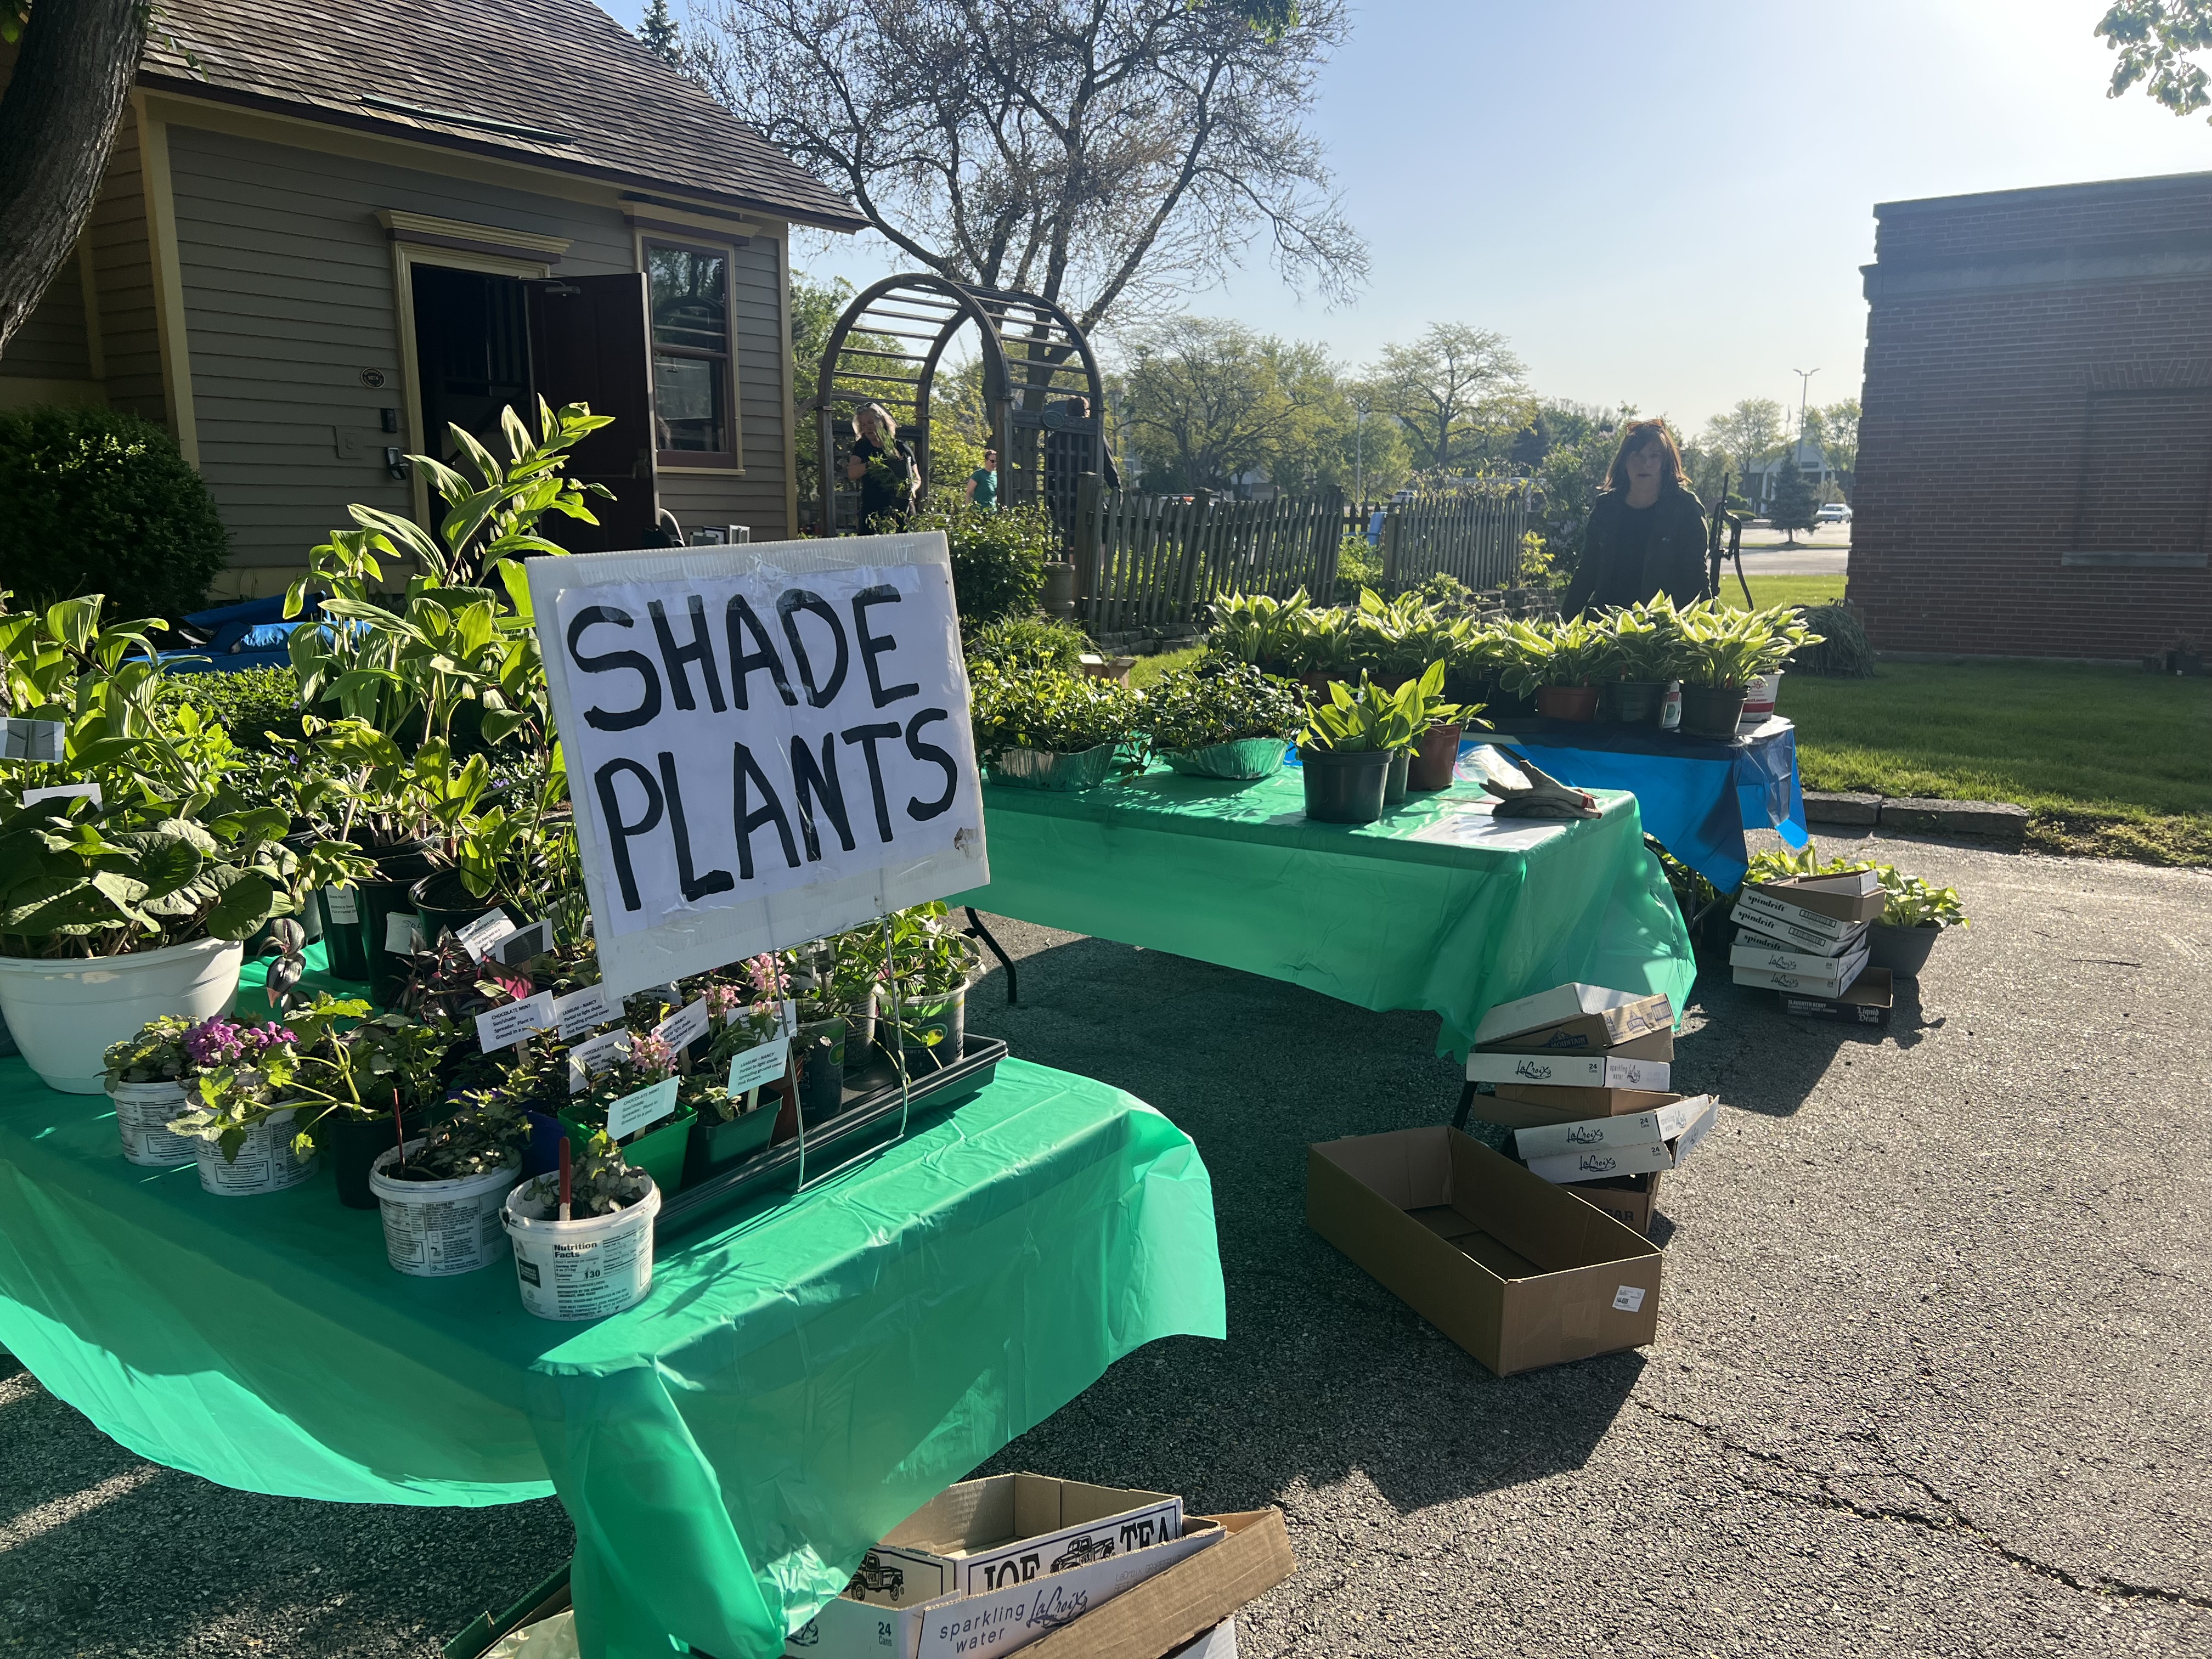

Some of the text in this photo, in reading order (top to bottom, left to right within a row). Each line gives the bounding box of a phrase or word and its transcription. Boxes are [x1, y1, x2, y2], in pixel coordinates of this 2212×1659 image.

[567, 584, 919, 731] SHADE
[594, 708, 958, 911] PLANTS
[1748, 894, 1785, 912] spindrift
[1737, 910, 1775, 929] spindrift
[1744, 933, 1781, 951] spindrift
[492, 1003, 531, 1020] CHOCOLATE MINT
[562, 999, 597, 1015] LAMIUM NANCY
[564, 1013, 577, 1022] Partial
[582, 1009, 591, 1017] light
[591, 1004, 602, 1012] shade
[1857, 1006, 1879, 1015] Liquid
[493, 1015, 517, 1027] Sun/shade
[565, 1019, 584, 1029] Spreading
[584, 1013, 599, 1022] ground
[675, 1016, 686, 1025] NANCY
[1858, 1014, 1878, 1023] Death
[494, 1024, 516, 1034] Spreader.
[495, 1031, 512, 1040] Ground
[1551, 1037, 1586, 1048] MOUNTAIN
[582, 1046, 604, 1057] CHOCOLATE
[741, 1058, 757, 1068] LAMIUM
[1515, 1060, 1551, 1079] LaCroix
[1610, 1064, 1628, 1074] sparkling
[738, 1071, 757, 1080] Spreading
[758, 1065, 771, 1073] ground
[623, 1087, 659, 1105] CHOCOLATE MINT
[621, 1115, 636, 1125] Ground
[1566, 1126, 1604, 1144] LaCroix
[1579, 1155, 1616, 1172] LaCroix
[1600, 1208, 1634, 1221] GAR
[554, 1242, 597, 1251] Nutrition
[584, 1269, 601, 1279] 130
[939, 1586, 1088, 1641] sparkling LaCroix
[878, 1621, 891, 1635] 24
[878, 1636, 893, 1647] Cans
[956, 1628, 1005, 1654] water
